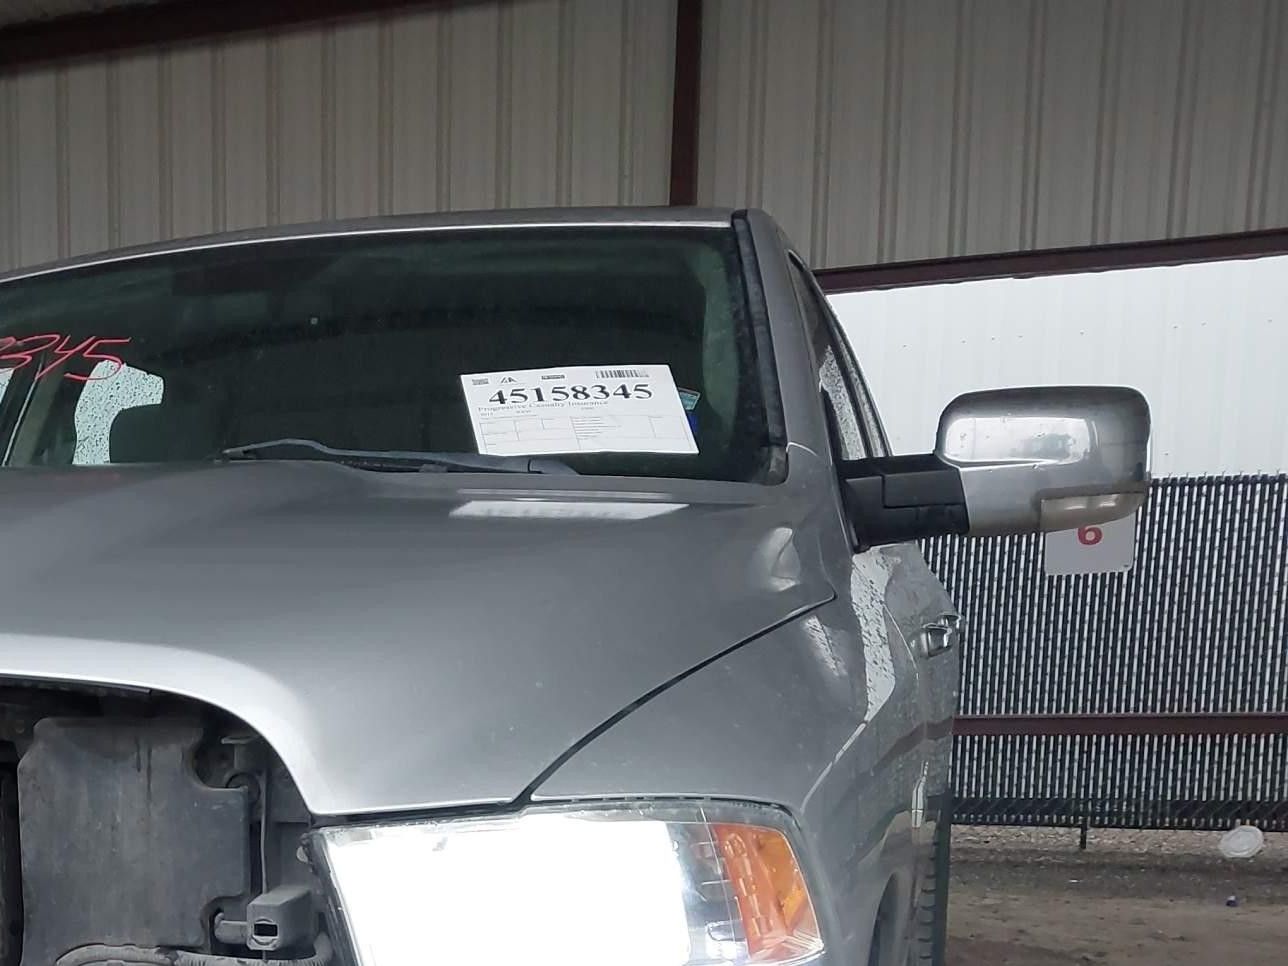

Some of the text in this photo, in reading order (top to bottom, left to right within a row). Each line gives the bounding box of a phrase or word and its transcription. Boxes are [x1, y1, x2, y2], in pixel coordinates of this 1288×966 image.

[488, 383, 653, 405] 45158345
[478, 403, 527, 413] Progressive
[568, 400, 609, 408] Insurance
[1077, 526, 1103, 545] 6
